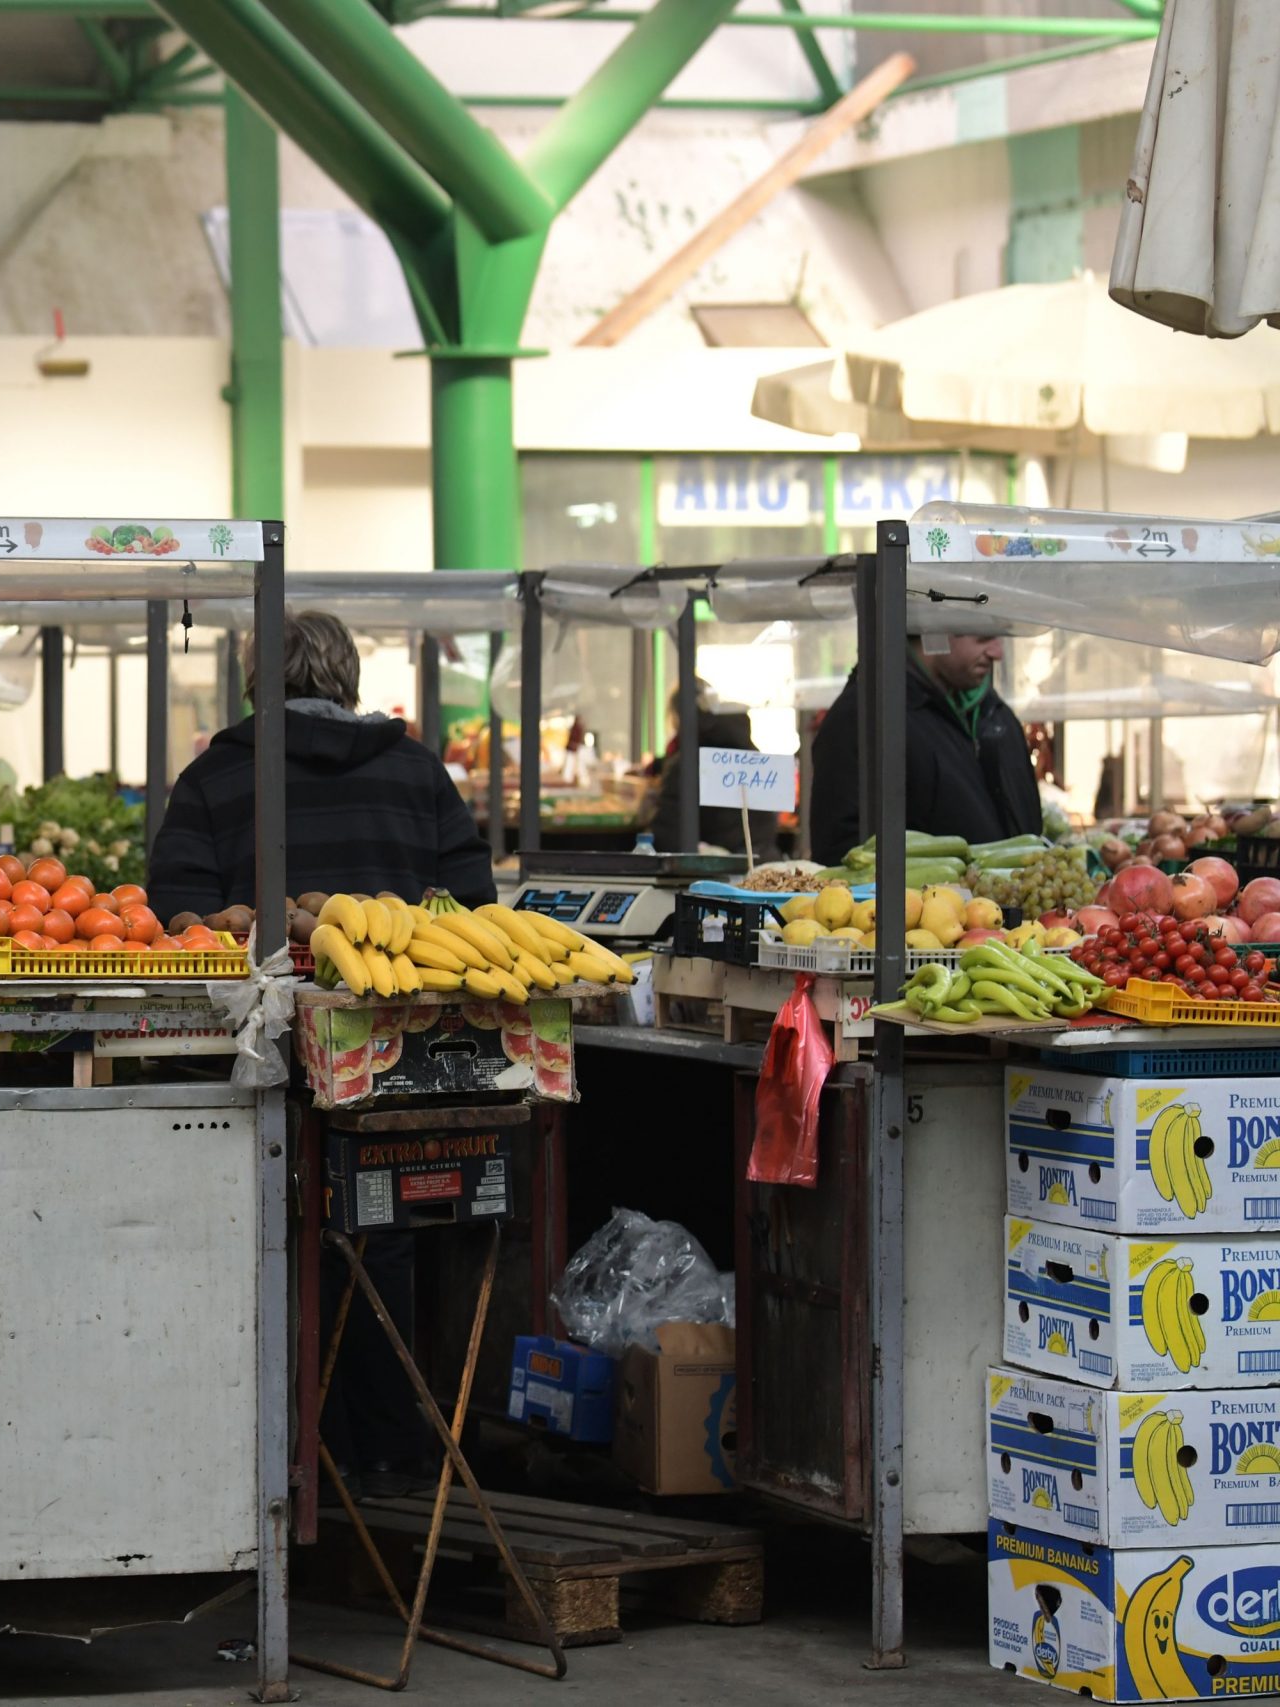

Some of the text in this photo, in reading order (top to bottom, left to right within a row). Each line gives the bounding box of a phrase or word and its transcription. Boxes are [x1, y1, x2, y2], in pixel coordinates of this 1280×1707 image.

[1141, 528, 1168, 543] 2m
[722, 771, 778, 789] ORAH
[1028, 1086, 1064, 1098] PREMIUM
[1065, 1090, 1084, 1102] PACK
[908, 1095, 923, 1123] 5
[360, 1135, 499, 1165] EXTRA FRUIT
[1039, 1166, 1078, 1206] BONITA
[1232, 1172, 1277, 1182] PREMIUM
[1028, 1233, 1061, 1251] PREMIUM
[1063, 1241, 1082, 1255] PACK
[1039, 1314, 1077, 1358] BONITA
[1225, 1326, 1272, 1336] PREMIUM
[1010, 1386, 1043, 1403] PREMIUM
[1046, 1395, 1065, 1408] PACK
[1212, 1401, 1275, 1414] PREMIUM
[1022, 1468, 1061, 1512] BONITA
[1214, 1479, 1259, 1489] PREMIUM
[996, 1535, 1099, 1575] PREMIUM BANANAS
[994, 1628, 1028, 1646] OF ECUADOR
[1035, 1644, 1057, 1662] derby
